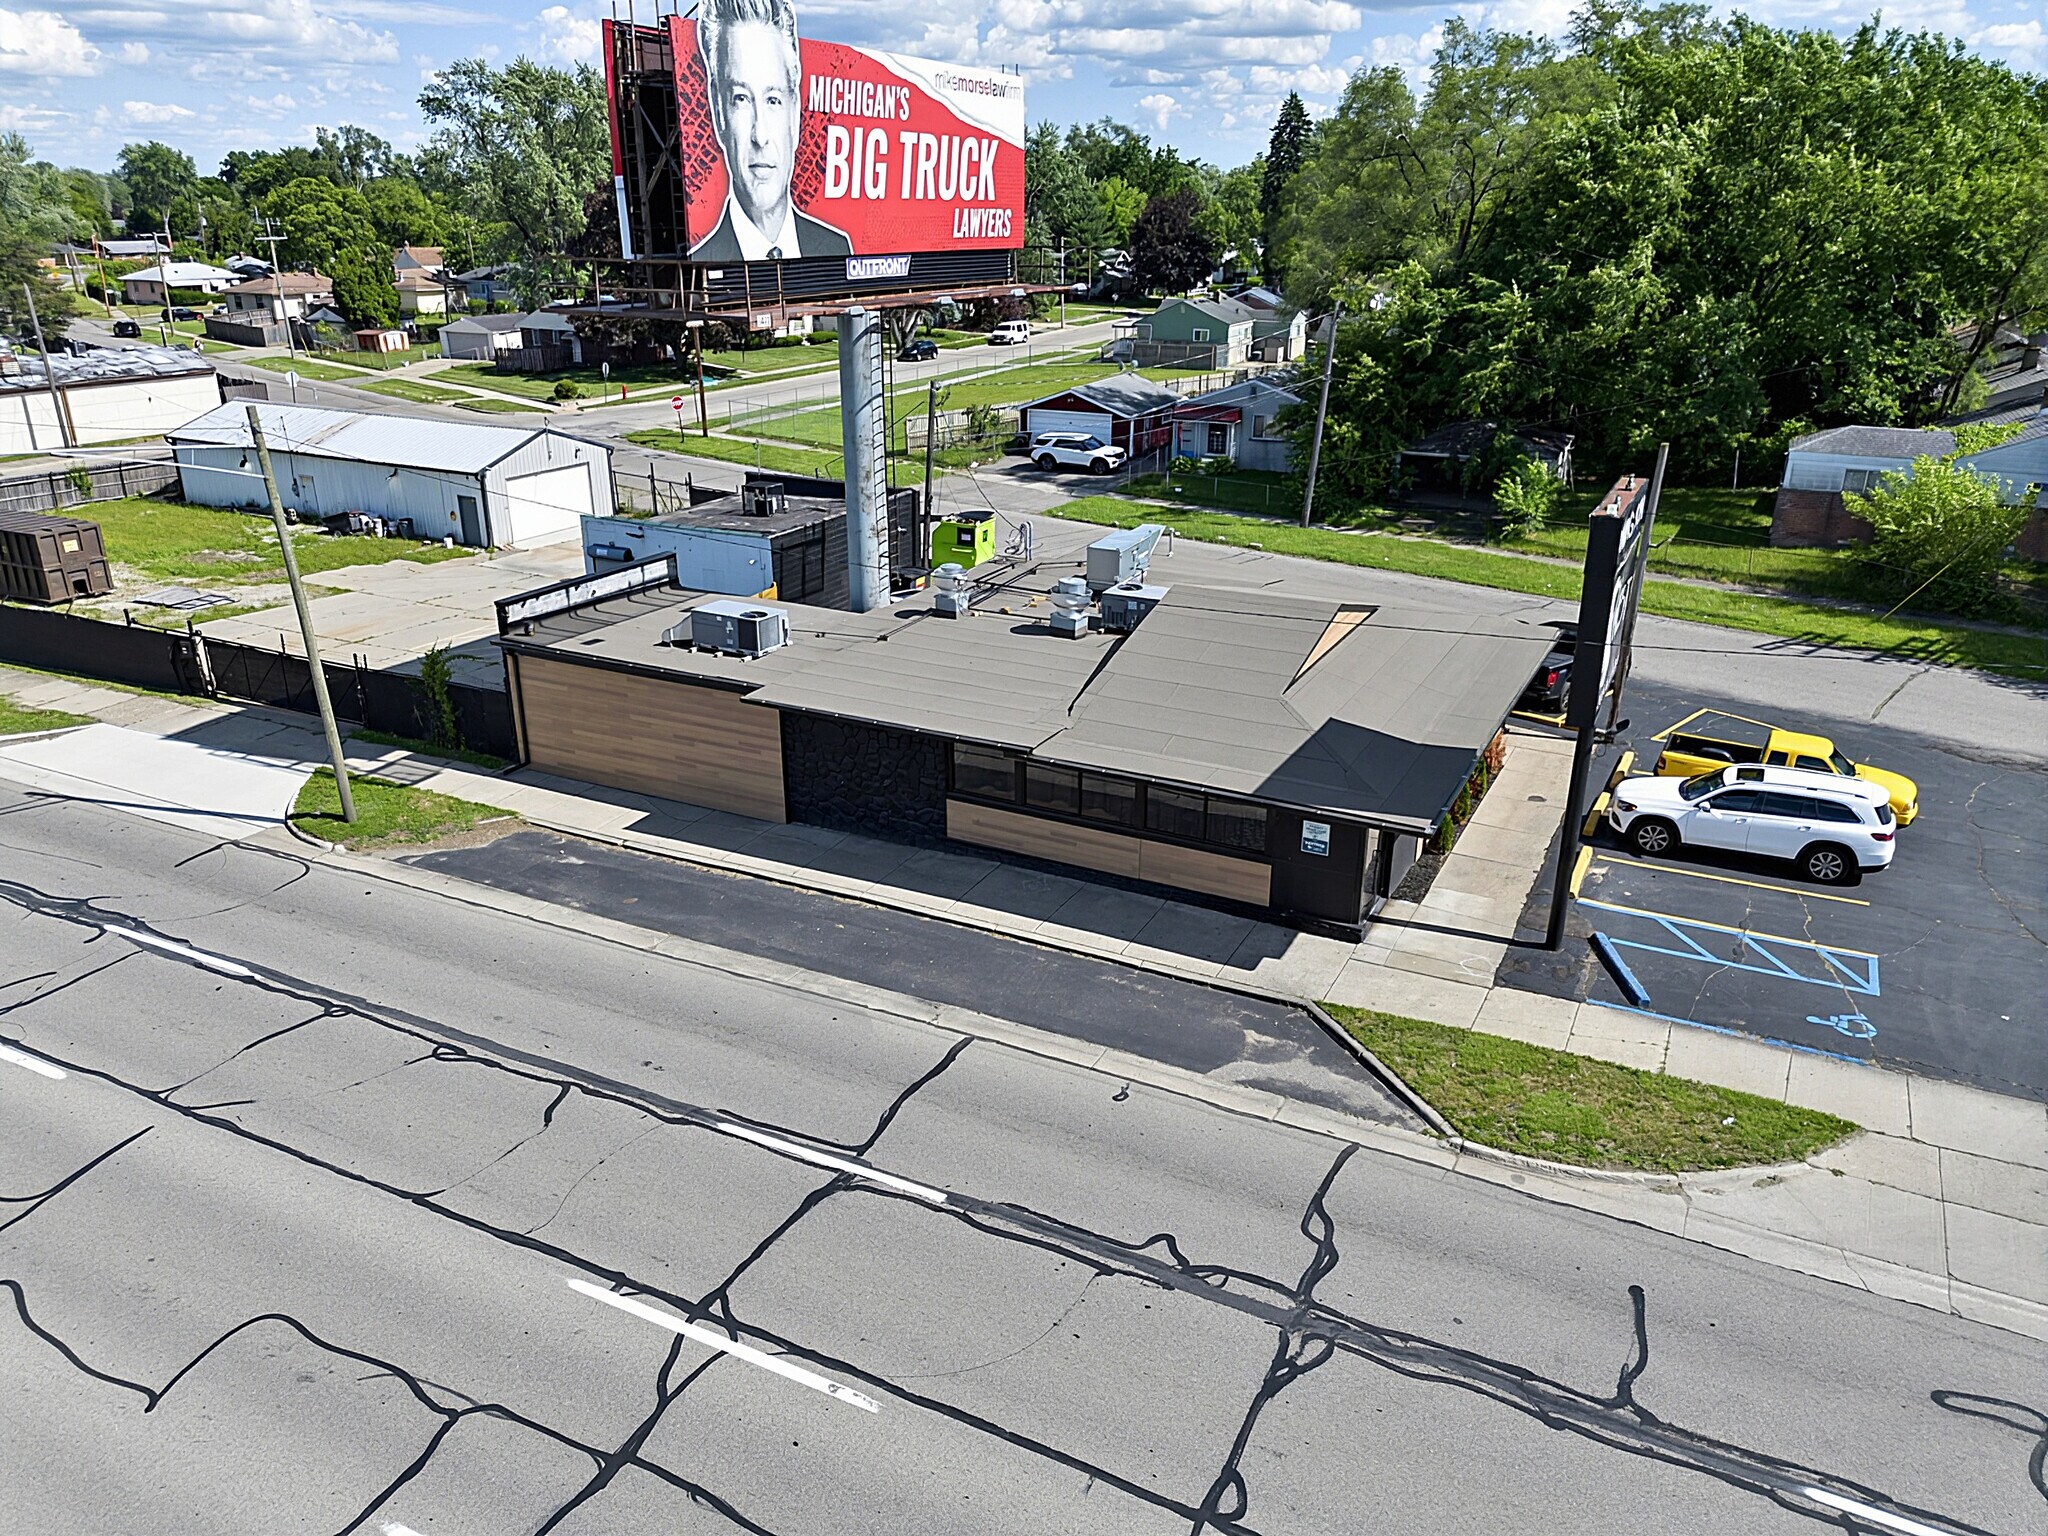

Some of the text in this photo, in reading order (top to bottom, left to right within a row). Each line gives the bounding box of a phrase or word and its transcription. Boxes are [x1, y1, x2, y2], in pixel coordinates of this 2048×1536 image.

[808, 74, 910, 121] MICHIGAN'S
[824, 124, 999, 201] BIG TRUCK
[953, 208, 1012, 238] LAWYERS
[849, 257, 908, 276] OUTFRONT
